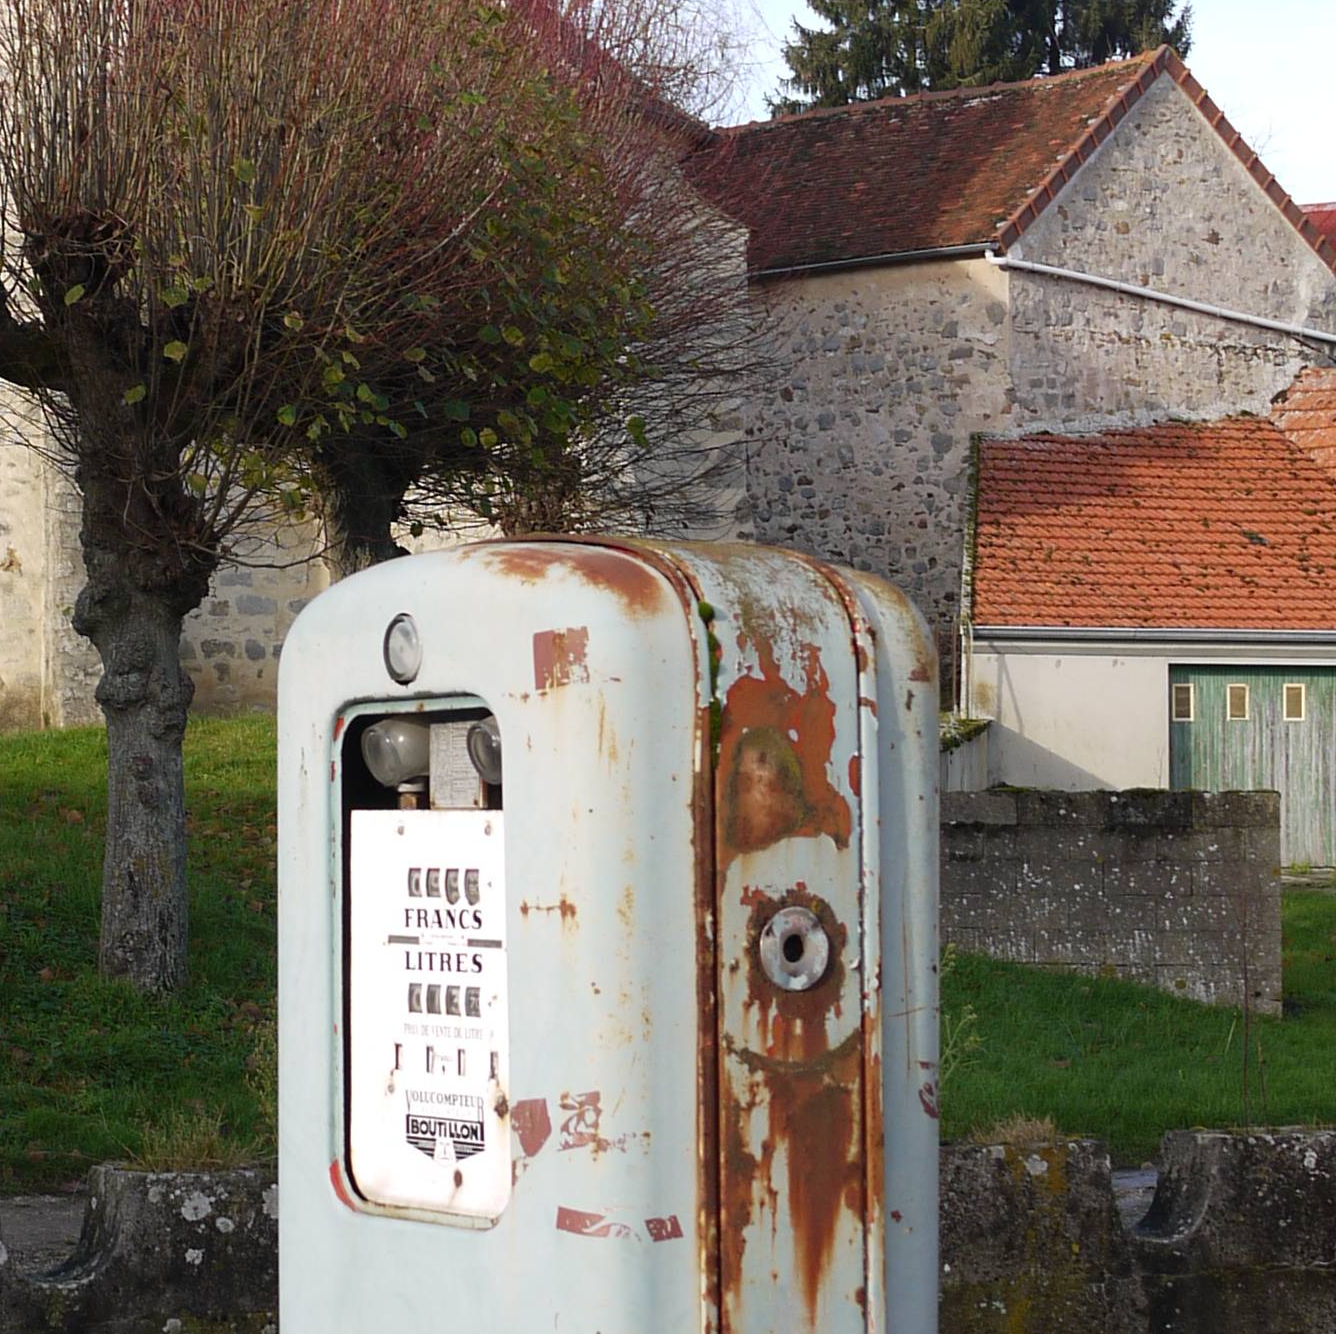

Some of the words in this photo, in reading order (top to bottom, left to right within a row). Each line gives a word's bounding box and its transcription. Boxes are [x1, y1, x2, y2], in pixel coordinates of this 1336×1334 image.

[404, 908, 483, 930] FRANCS
[405, 950, 483, 974] LITRES
[421, 1024, 429, 1036] DE
[431, 1025, 452, 1038] VENTE
[464, 1027, 483, 1040] LITRE
[410, 1118, 479, 1141] BOUTILLON
